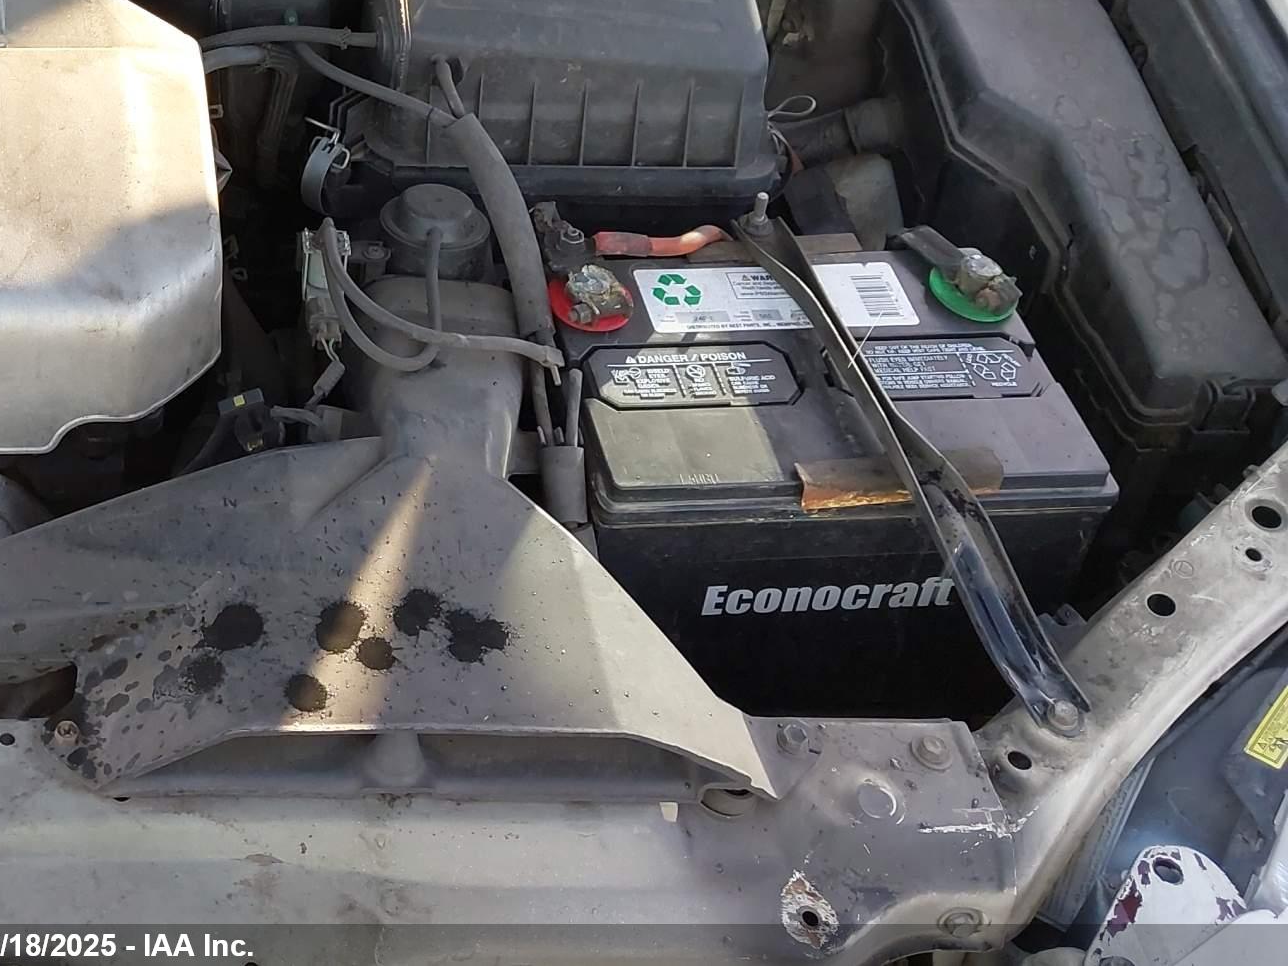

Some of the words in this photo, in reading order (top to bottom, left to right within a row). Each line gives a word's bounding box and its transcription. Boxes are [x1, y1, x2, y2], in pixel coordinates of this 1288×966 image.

[637, 354, 689, 363] DANGER
[700, 351, 747, 361] POISON
[700, 576, 955, 616] Econocraft
